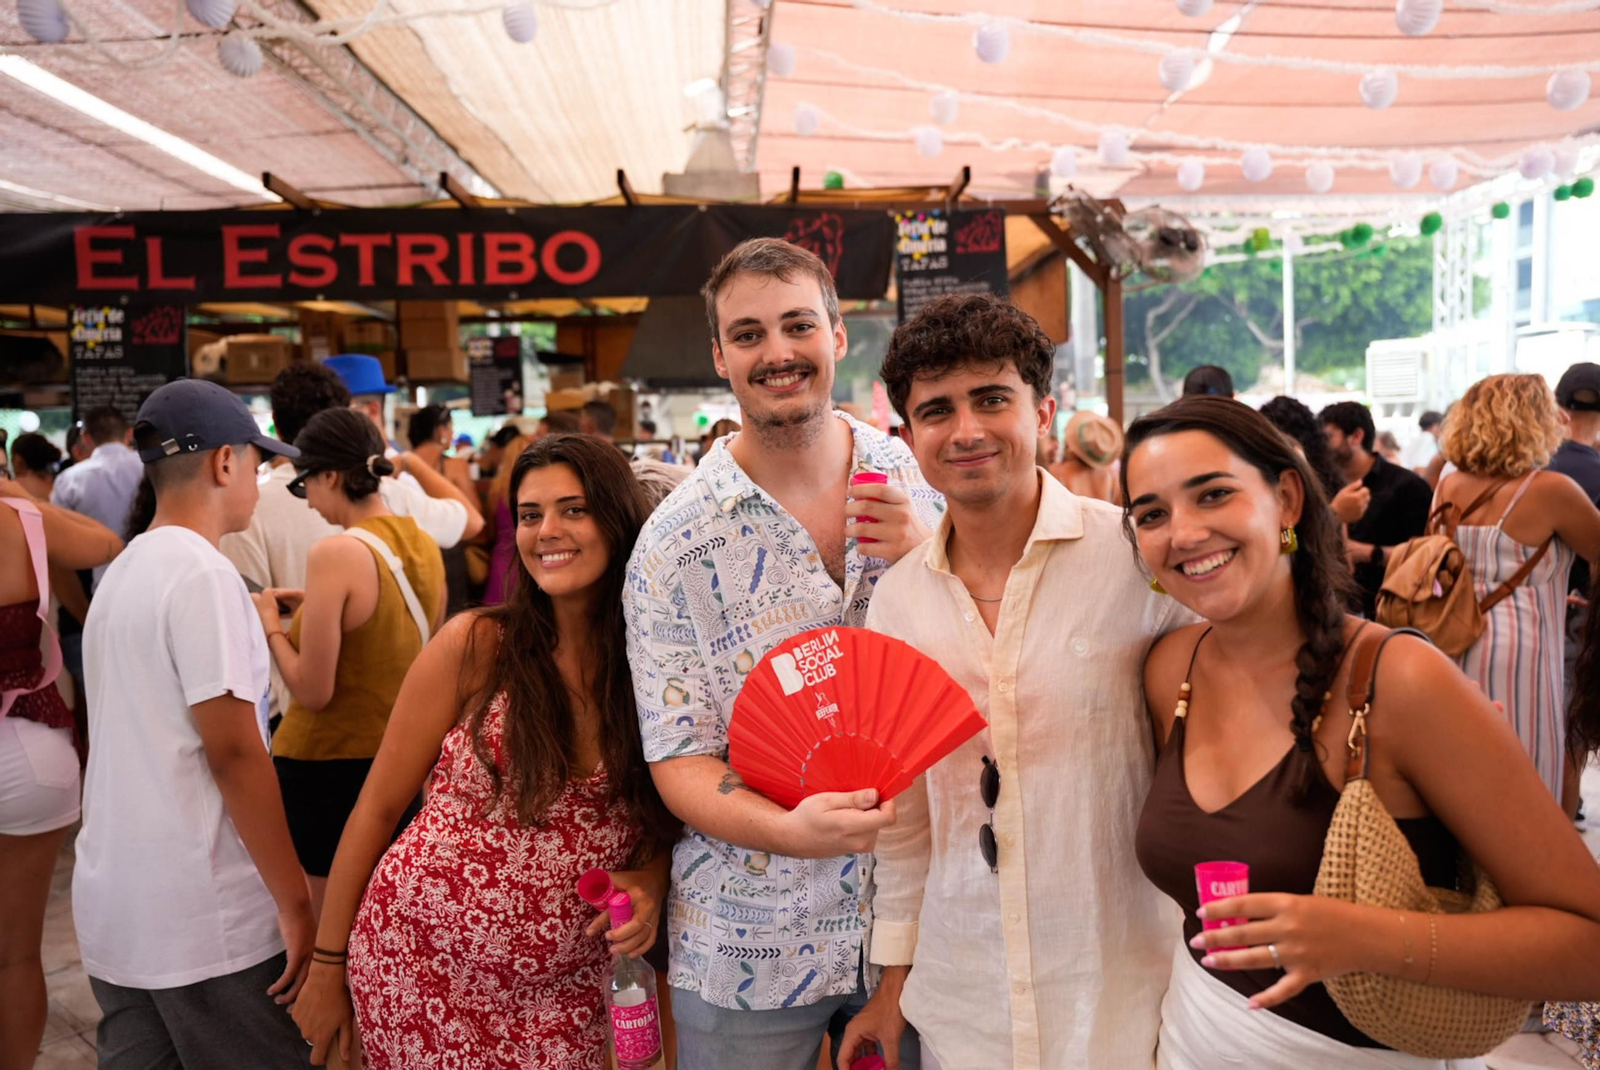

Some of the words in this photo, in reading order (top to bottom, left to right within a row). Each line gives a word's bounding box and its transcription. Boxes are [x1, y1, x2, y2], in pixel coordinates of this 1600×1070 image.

[221, 224, 602, 288] ESTRIBO
[792, 629, 840, 661] BERLIN
[798, 645, 844, 674] SOCIAL
[804, 663, 837, 687] CLUB
[615, 1011, 655, 1030] CARTOJAL
